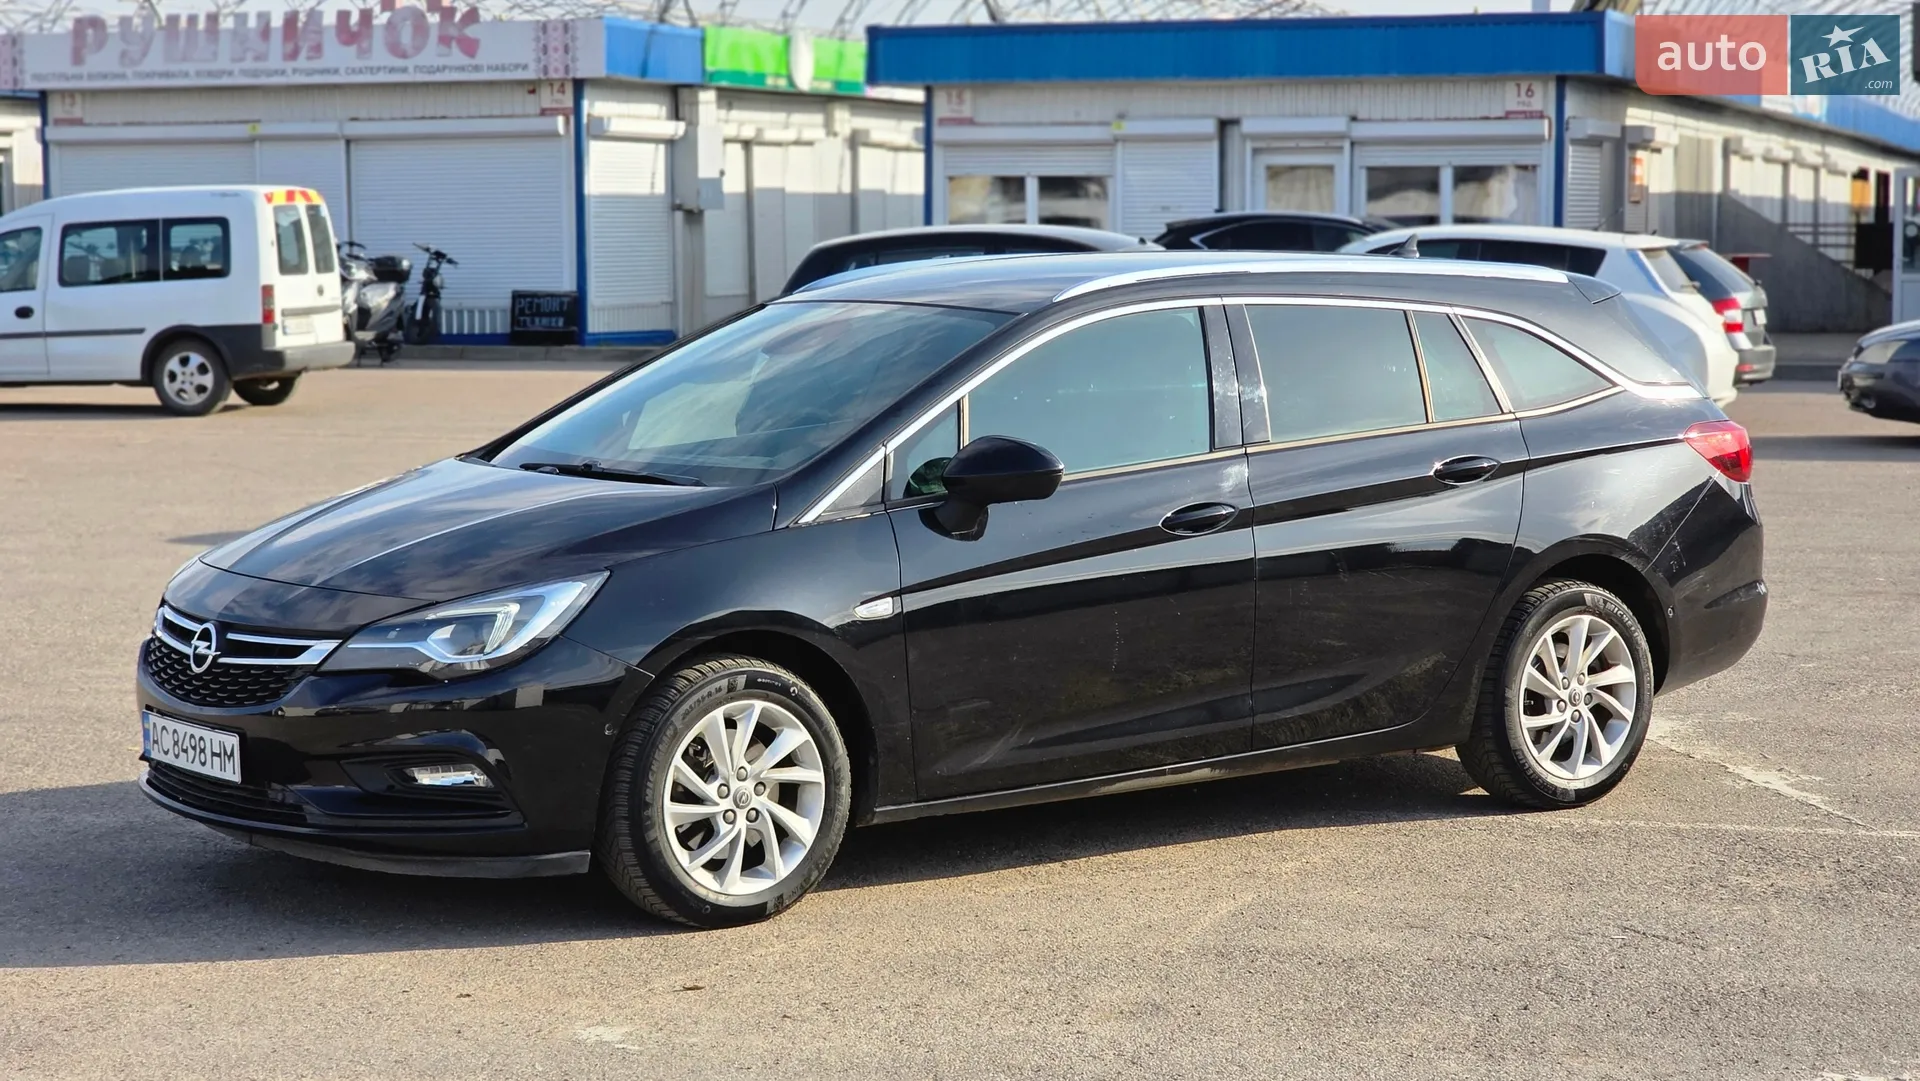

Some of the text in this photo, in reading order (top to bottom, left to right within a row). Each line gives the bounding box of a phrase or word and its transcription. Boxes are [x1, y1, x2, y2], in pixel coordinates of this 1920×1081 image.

[70, 6, 482, 68] РУШНИЧОК
[344, 65, 411, 76] СКАТЕРТИНИ,
[413, 63, 485, 75] ПОДАРУНКОВІ
[486, 62, 530, 73] НАБОРИ
[548, 82, 566, 97] 14
[1515, 82, 1535, 98] 16
[514, 296, 571, 316] РЕМОНТ
[1605, 600, 1644, 646] MICHELIN
[152, 722, 236, 775] AC 8498 HM
